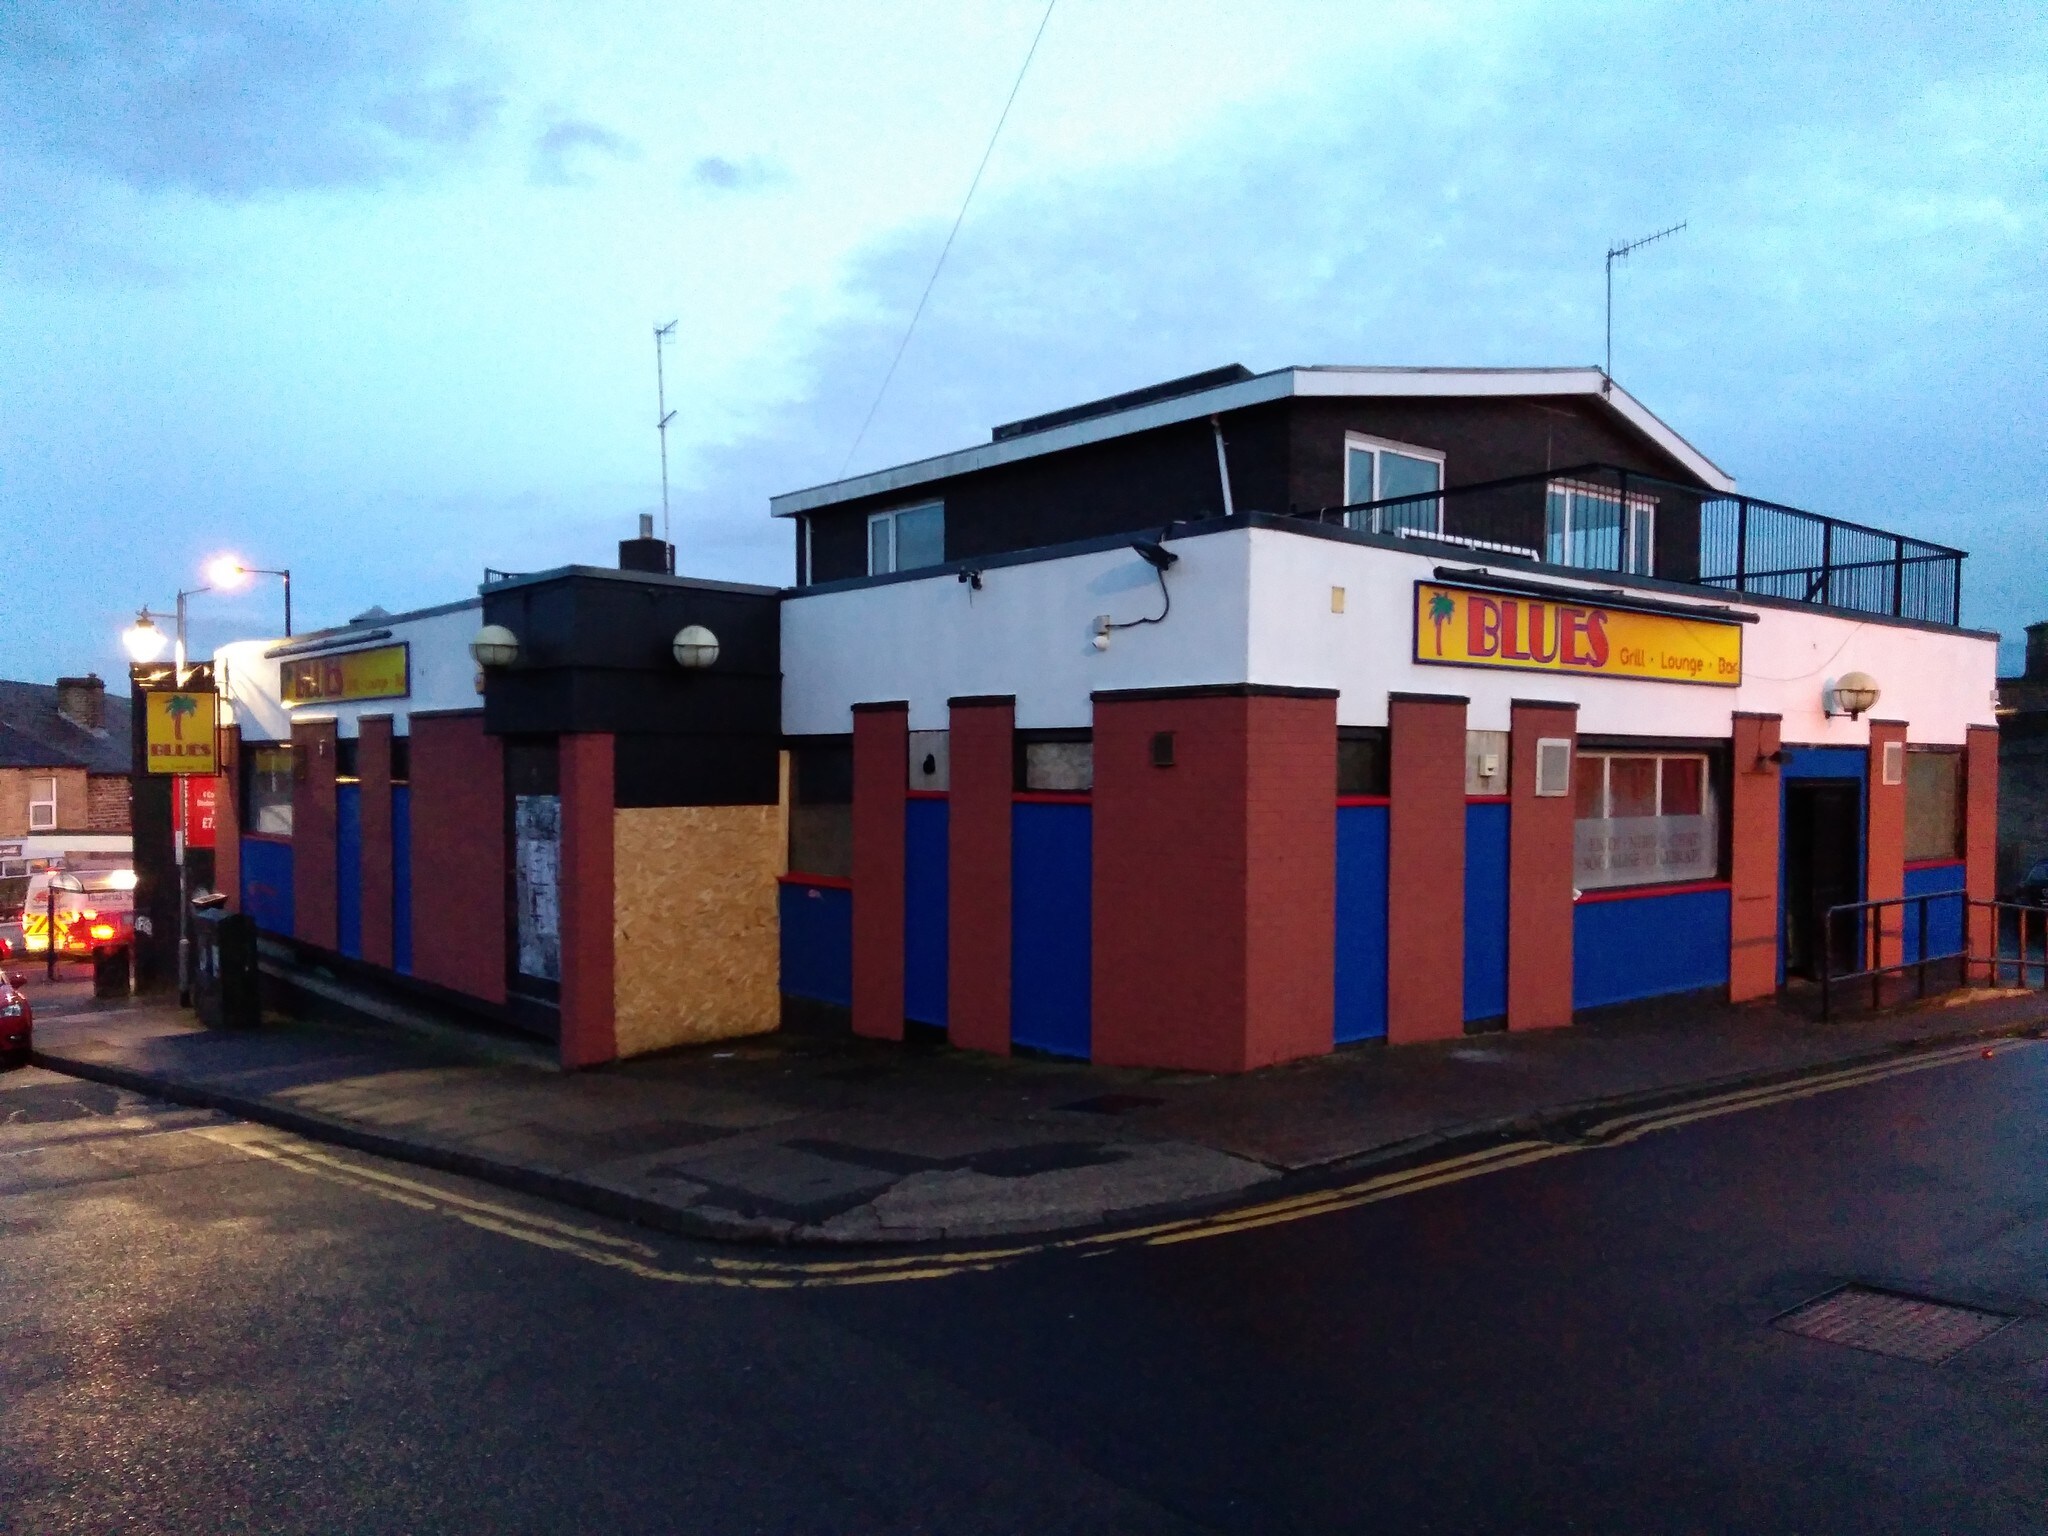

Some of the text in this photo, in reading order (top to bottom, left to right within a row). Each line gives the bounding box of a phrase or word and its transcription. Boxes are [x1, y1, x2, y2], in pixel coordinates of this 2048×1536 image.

[1467, 596, 1609, 668] BLUES
[1620, 647, 1738, 676] Grill Lounge Bar
[151, 743, 211, 757] BLUES
